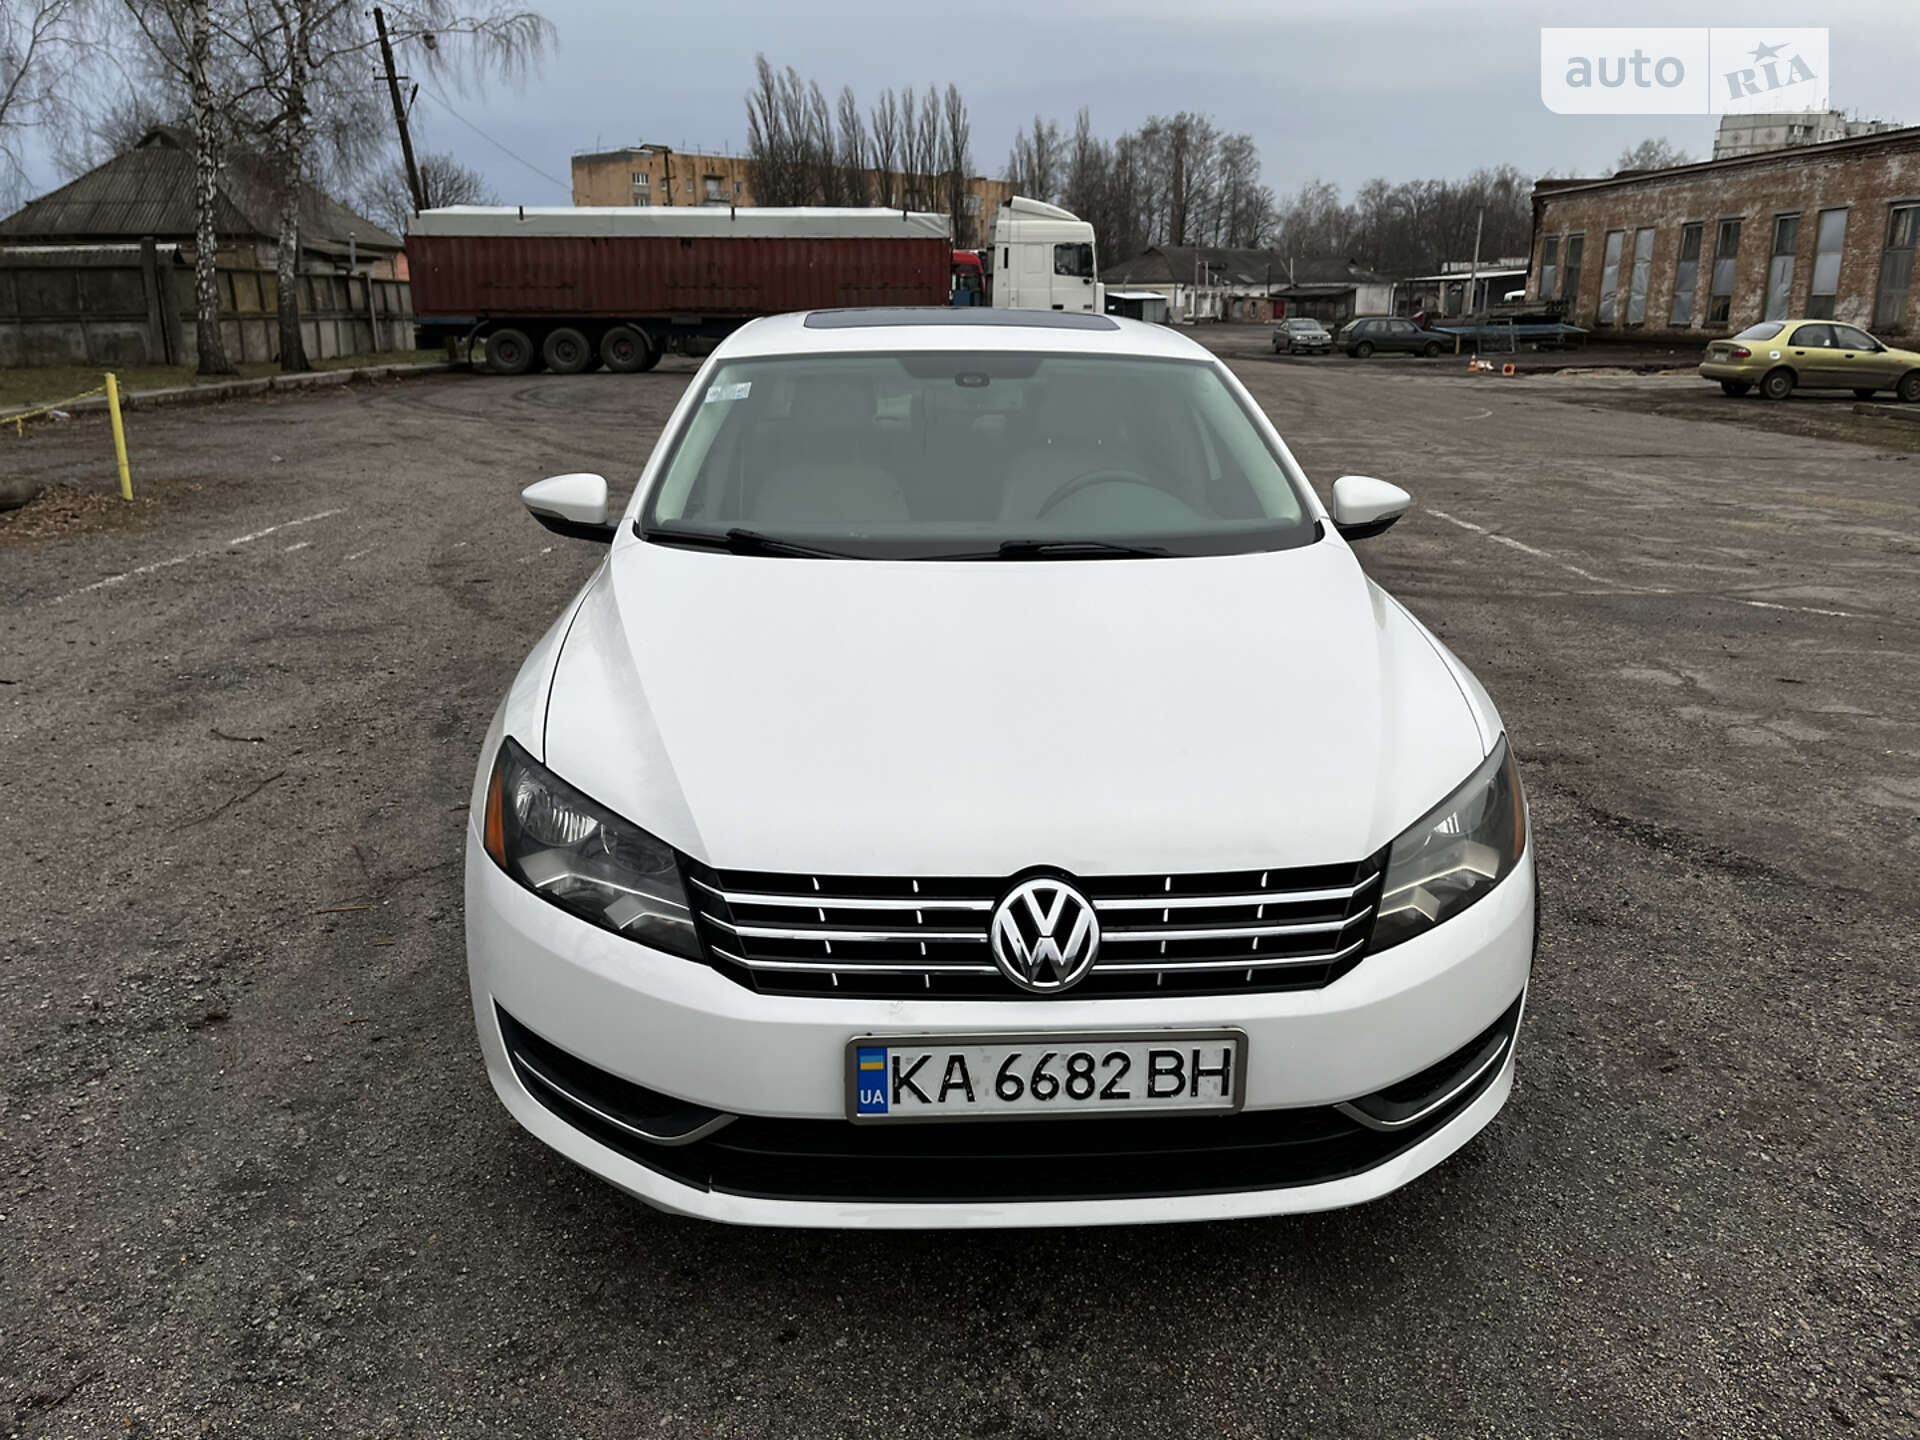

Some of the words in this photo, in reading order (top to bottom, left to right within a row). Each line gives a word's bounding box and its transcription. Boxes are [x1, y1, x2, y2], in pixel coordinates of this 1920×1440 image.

[1000, 884, 1093, 984] VW
[860, 1089, 885, 1105] UA
[892, 1054, 976, 1104] KA
[995, 1052, 1131, 1101] 6682
[1147, 1047, 1231, 1098] BH
